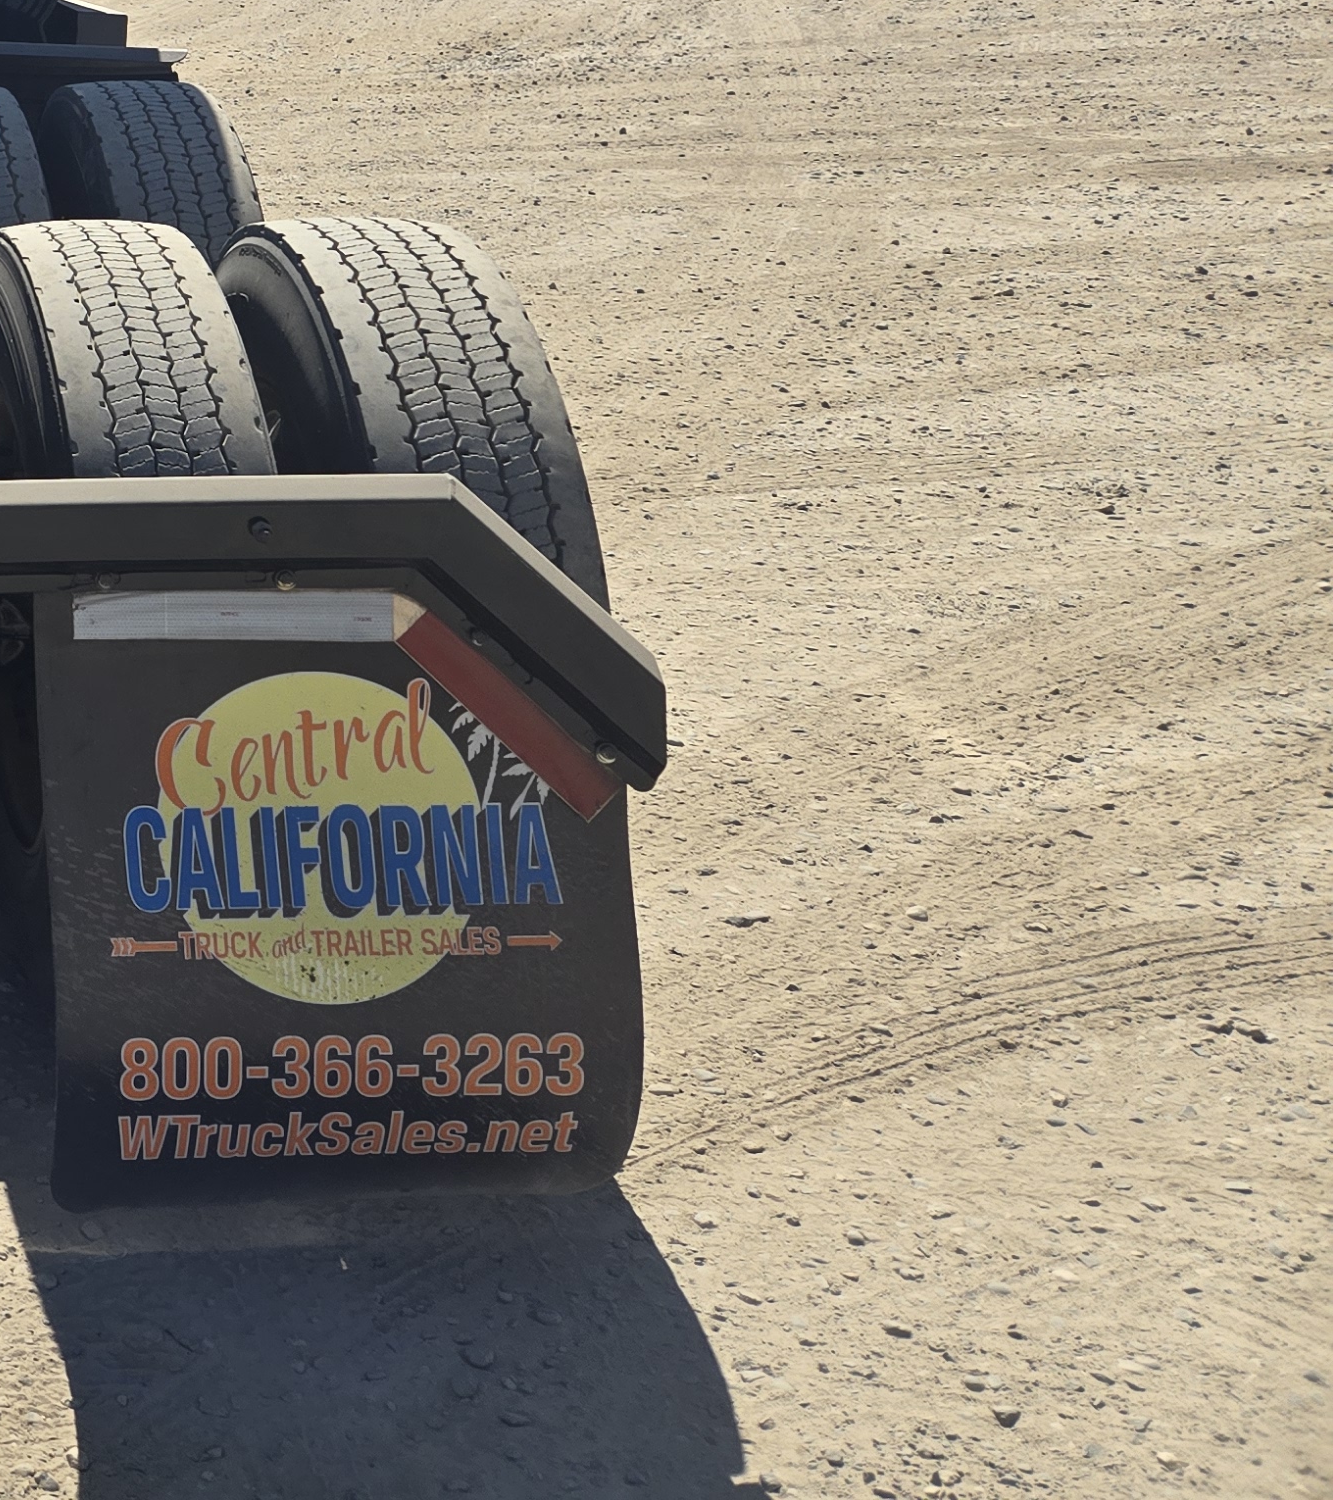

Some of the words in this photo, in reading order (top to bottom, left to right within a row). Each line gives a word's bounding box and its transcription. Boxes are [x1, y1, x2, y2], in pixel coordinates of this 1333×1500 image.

[155, 678, 436, 816] Central
[123, 802, 564, 918] CALIFORNIA
[178, 930, 264, 961] TRUCK
[271, 924, 307, 959] and
[312, 928, 414, 957] TRAILER
[421, 926, 503, 956] SALES
[119, 1033, 586, 1102] 800-366-3263
[118, 1110, 579, 1161] WTruckSales.net
